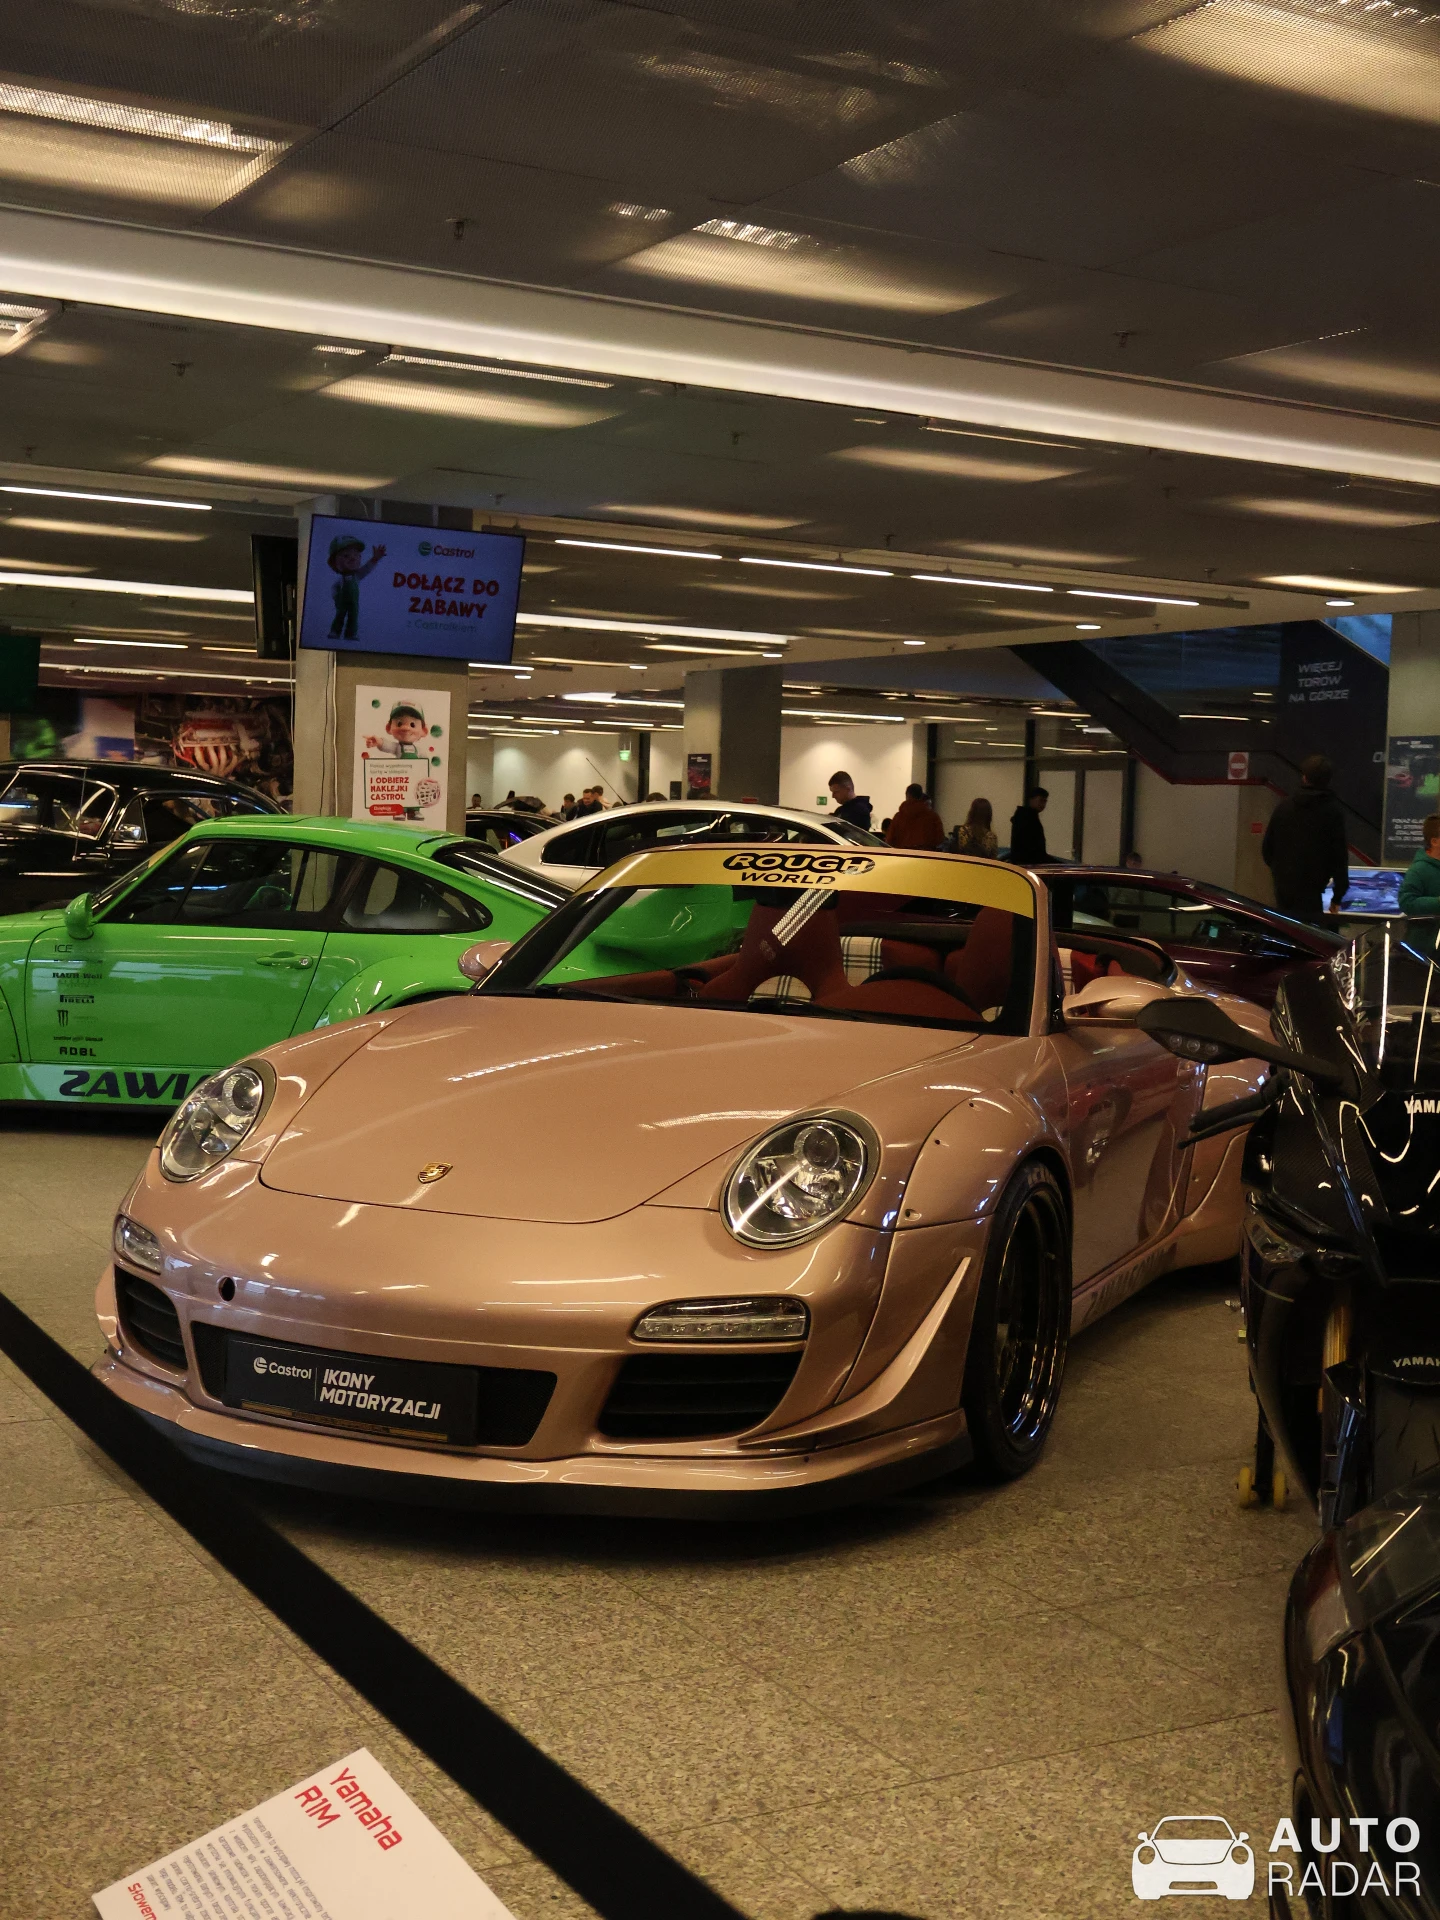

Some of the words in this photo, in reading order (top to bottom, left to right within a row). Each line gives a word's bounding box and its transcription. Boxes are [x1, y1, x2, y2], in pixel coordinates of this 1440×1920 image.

[433, 544, 475, 559] Castrol
[393, 572, 465, 597] DOŁĄCZ
[473, 578, 499, 596] DO
[408, 596, 487, 618] ZABAWY
[1288, 692, 1305, 703] NA
[370, 785, 408, 793] NAKLEJKI
[375, 776, 410, 784] ODBIERZ
[370, 793, 406, 801] CASTROL
[724, 853, 875, 875] ROUGH
[741, 872, 836, 885] WORLD
[60, 994, 95, 1004] PIRELLI
[59, 1069, 212, 1100] ZAWI
[268, 1361, 312, 1380] Castrol
[323, 1368, 375, 1391] IKONY
[319, 1387, 441, 1420] MOTORYZACJI
[294, 1785, 342, 1829] R1M
[329, 1767, 403, 1851] Yamaha
